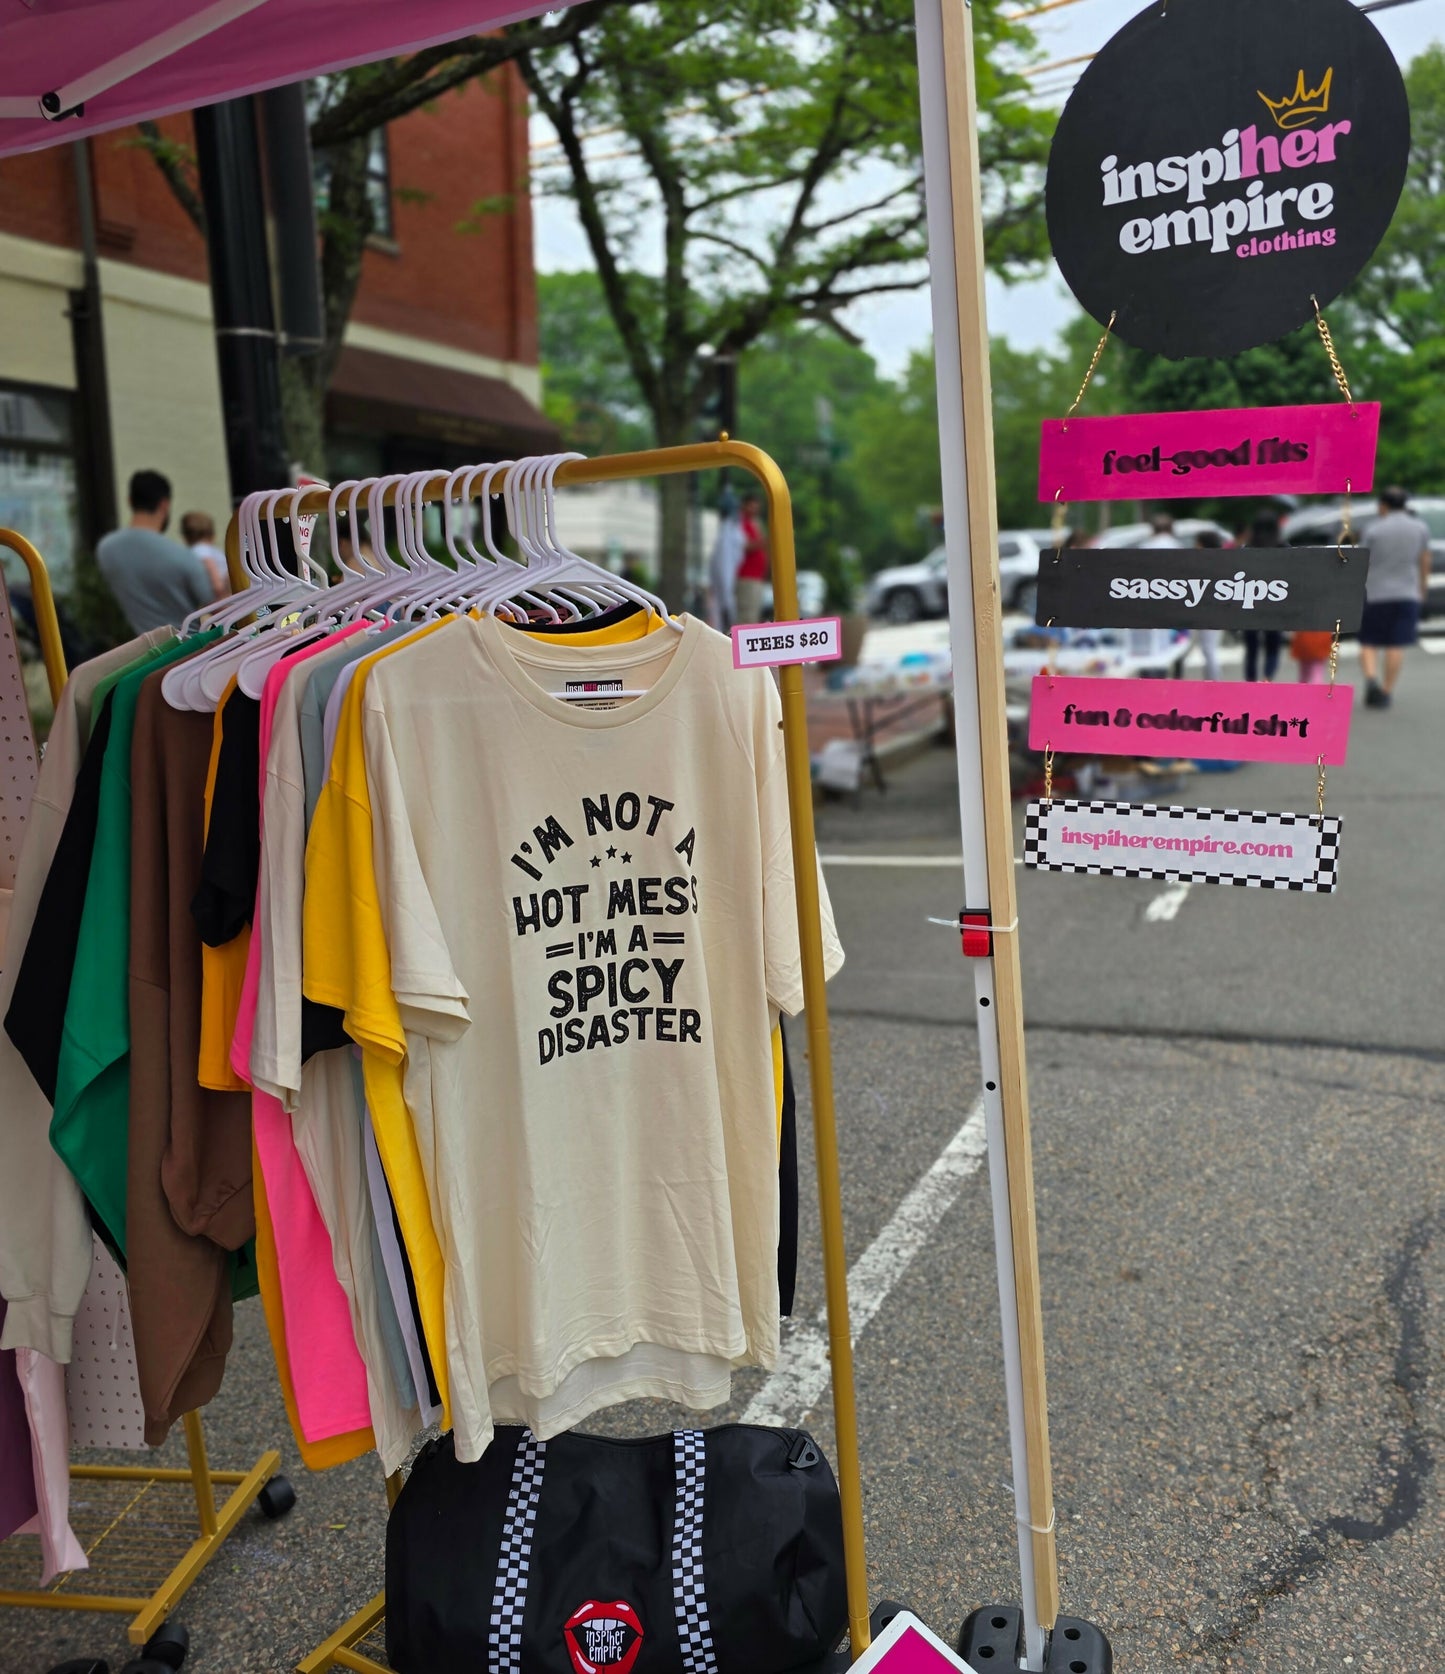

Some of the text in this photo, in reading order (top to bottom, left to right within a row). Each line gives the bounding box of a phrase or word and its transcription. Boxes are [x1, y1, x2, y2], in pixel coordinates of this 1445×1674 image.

[1100, 120, 1351, 206] inspiher
[1119, 180, 1334, 254] empire
[1236, 226, 1337, 258] clothing
[1103, 437, 1309, 475] feel-good fits
[1109, 571, 1289, 610] sassy sips
[746, 630, 828, 653] TEES $20
[1063, 703, 1110, 727] fun
[1136, 708, 1250, 735] colorful
[510, 791, 697, 882] I'M NOT A
[1061, 825, 1293, 858] inspiherempire.com
[512, 874, 698, 936] HOT MESS
[577, 924, 649, 960] I'M A
[547, 957, 685, 1019] SPICY
[538, 1007, 702, 1066] DISASTER
[585, 1629, 626, 1647] inspiher
[588, 1644, 622, 1663] empire
